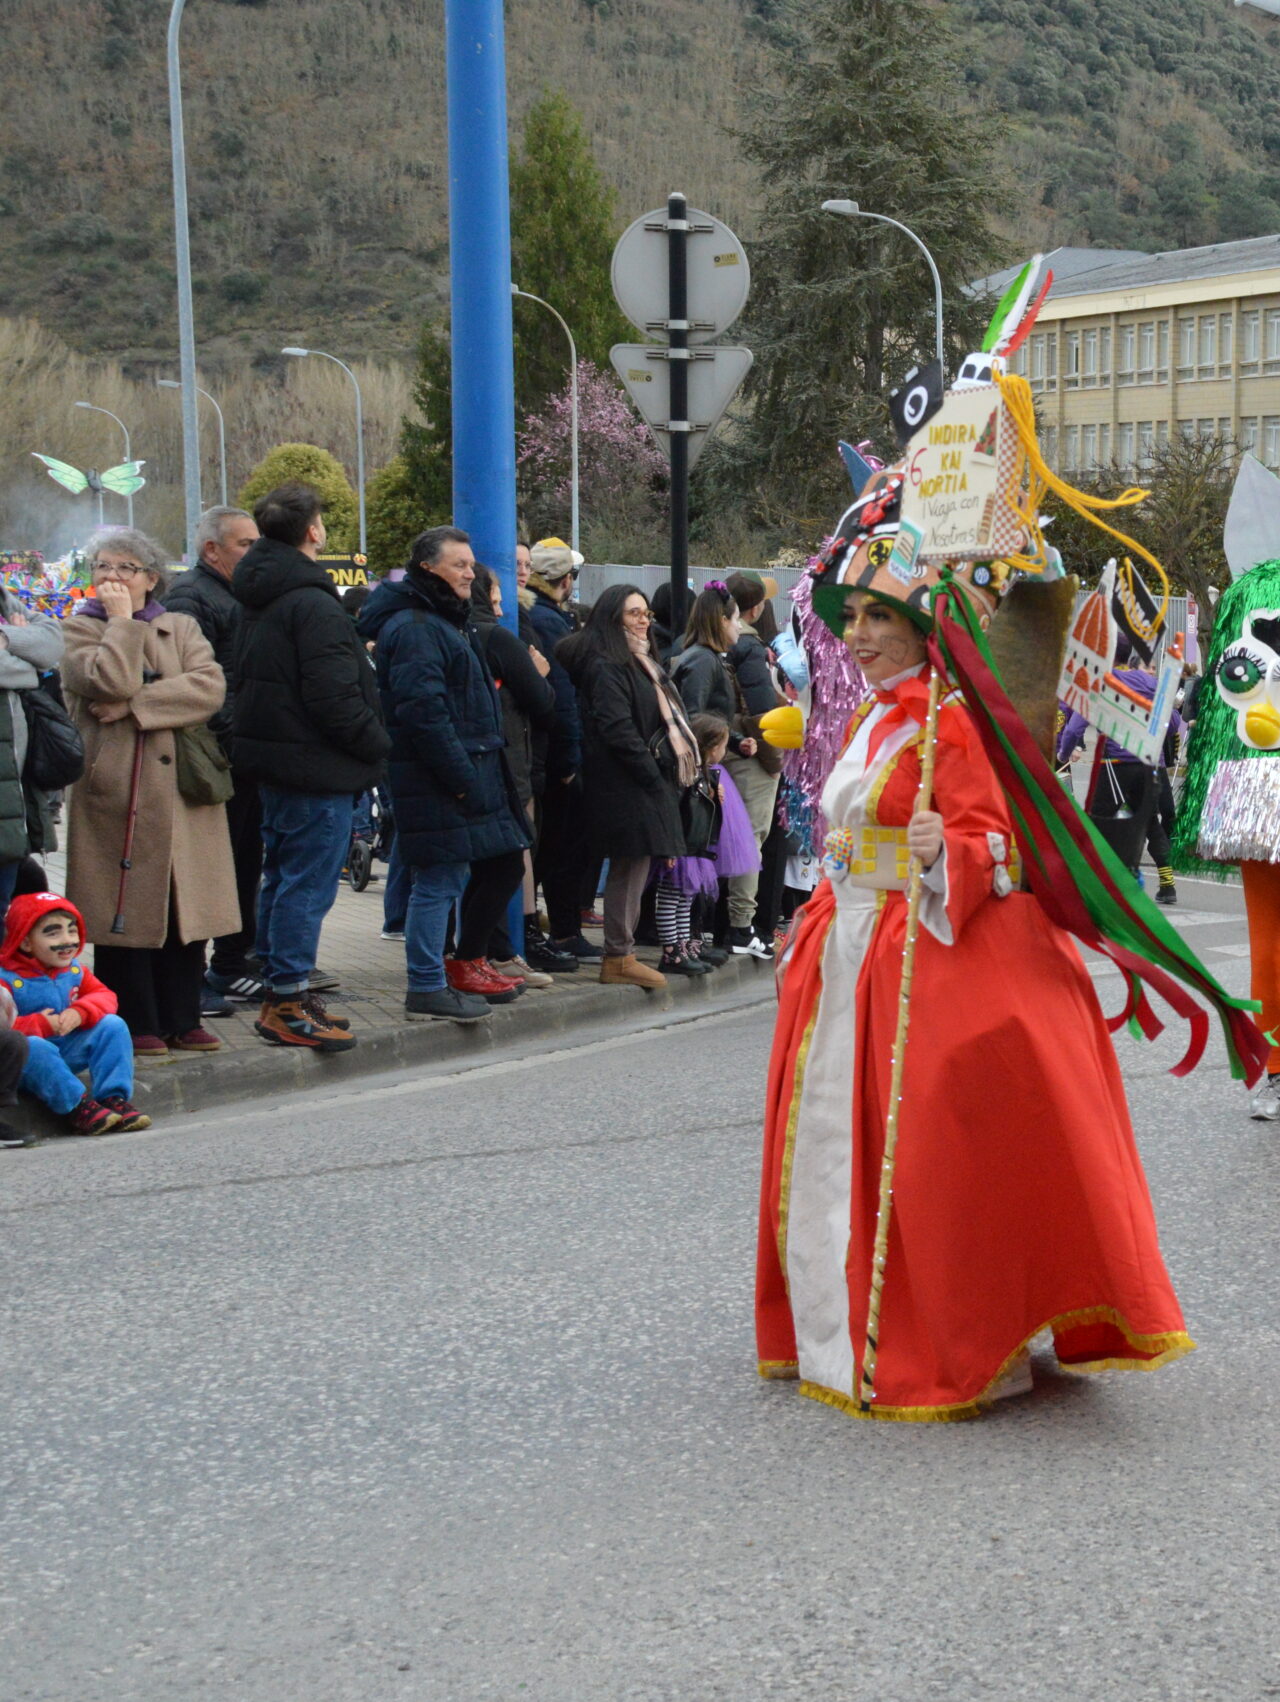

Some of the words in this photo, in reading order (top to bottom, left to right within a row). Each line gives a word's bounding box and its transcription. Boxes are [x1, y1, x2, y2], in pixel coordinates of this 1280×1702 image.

[928, 424, 977, 446] INDIRA
[940, 450, 962, 471] KAI
[960, 496, 979, 509] con
